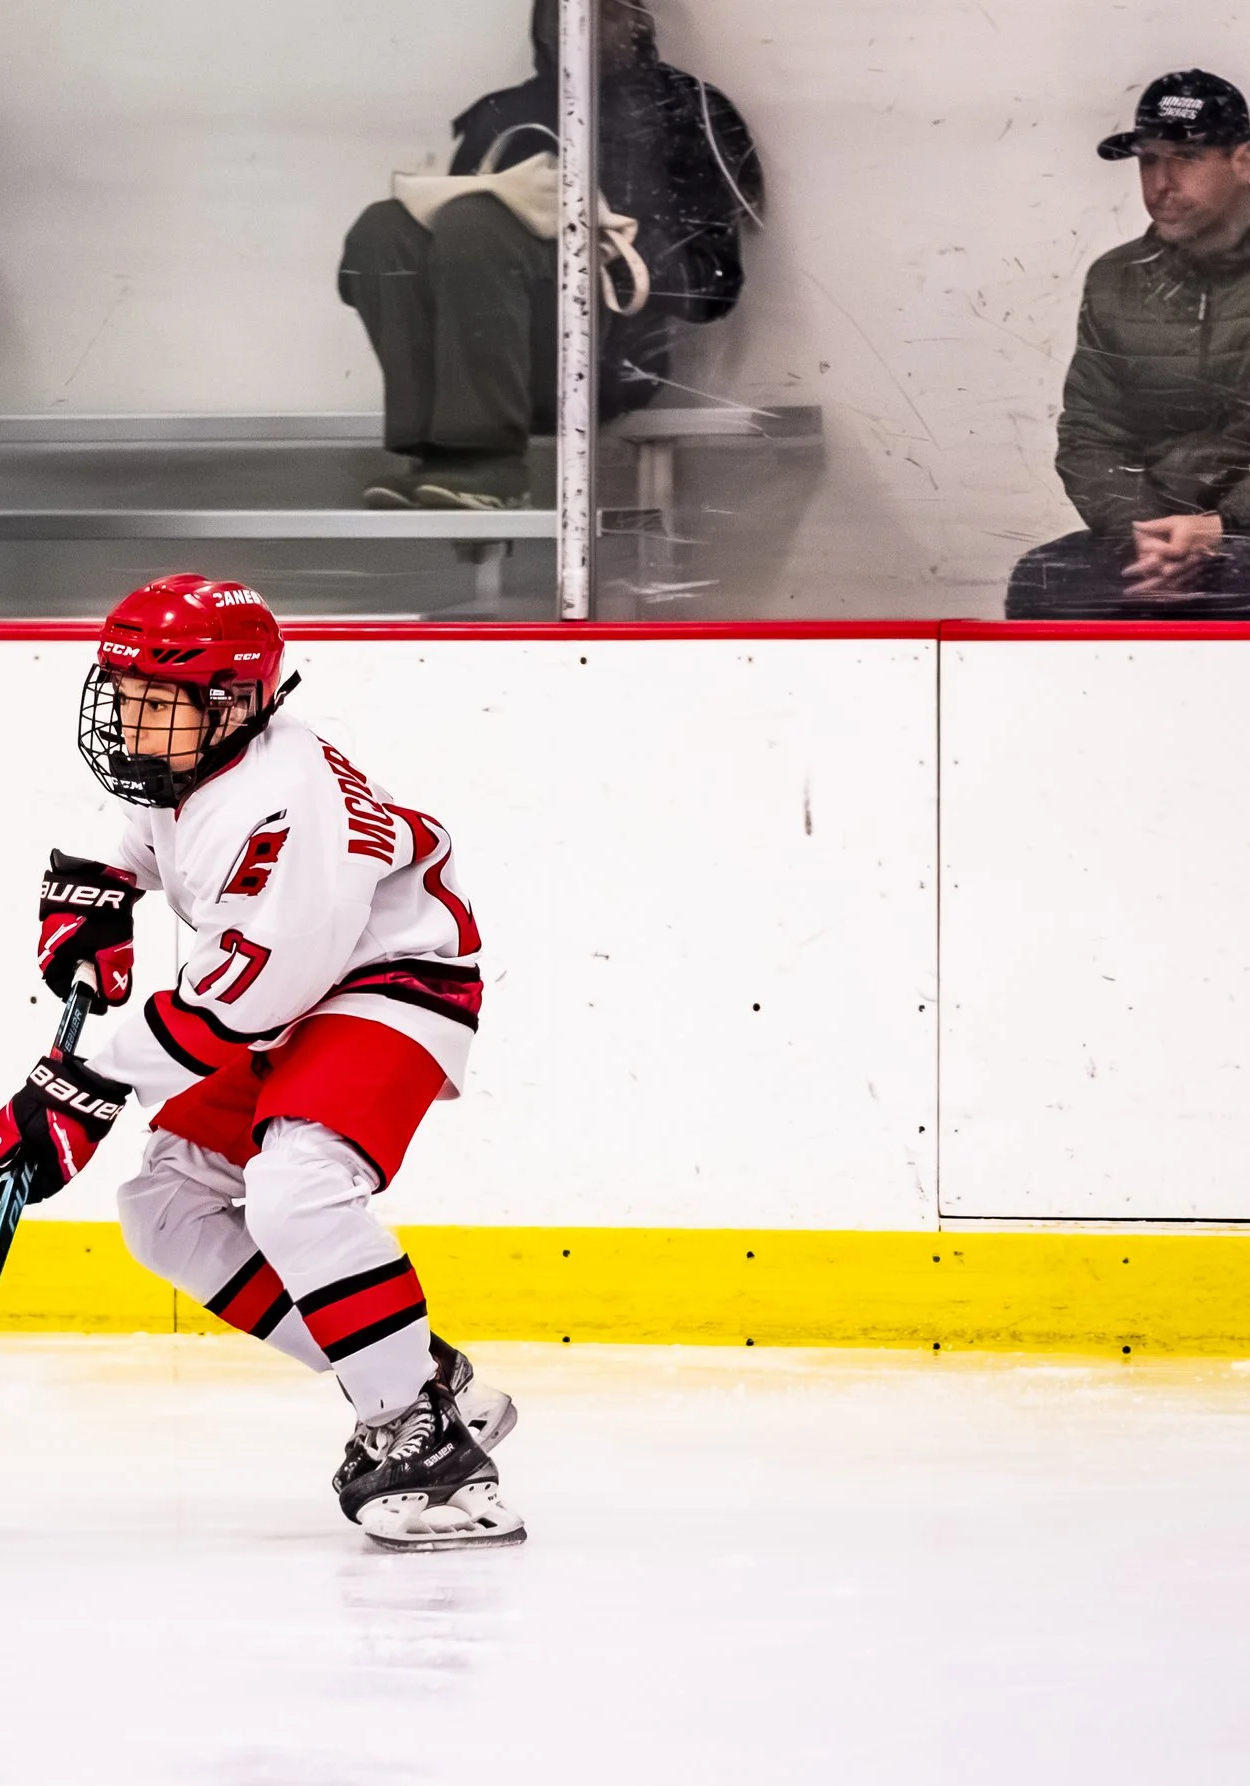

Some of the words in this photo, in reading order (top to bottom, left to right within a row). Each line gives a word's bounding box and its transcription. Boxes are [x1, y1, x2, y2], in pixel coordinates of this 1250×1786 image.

[103, 641, 140, 658] CCM
[234, 652, 261, 661] CCM
[40, 881, 125, 909] AUER
